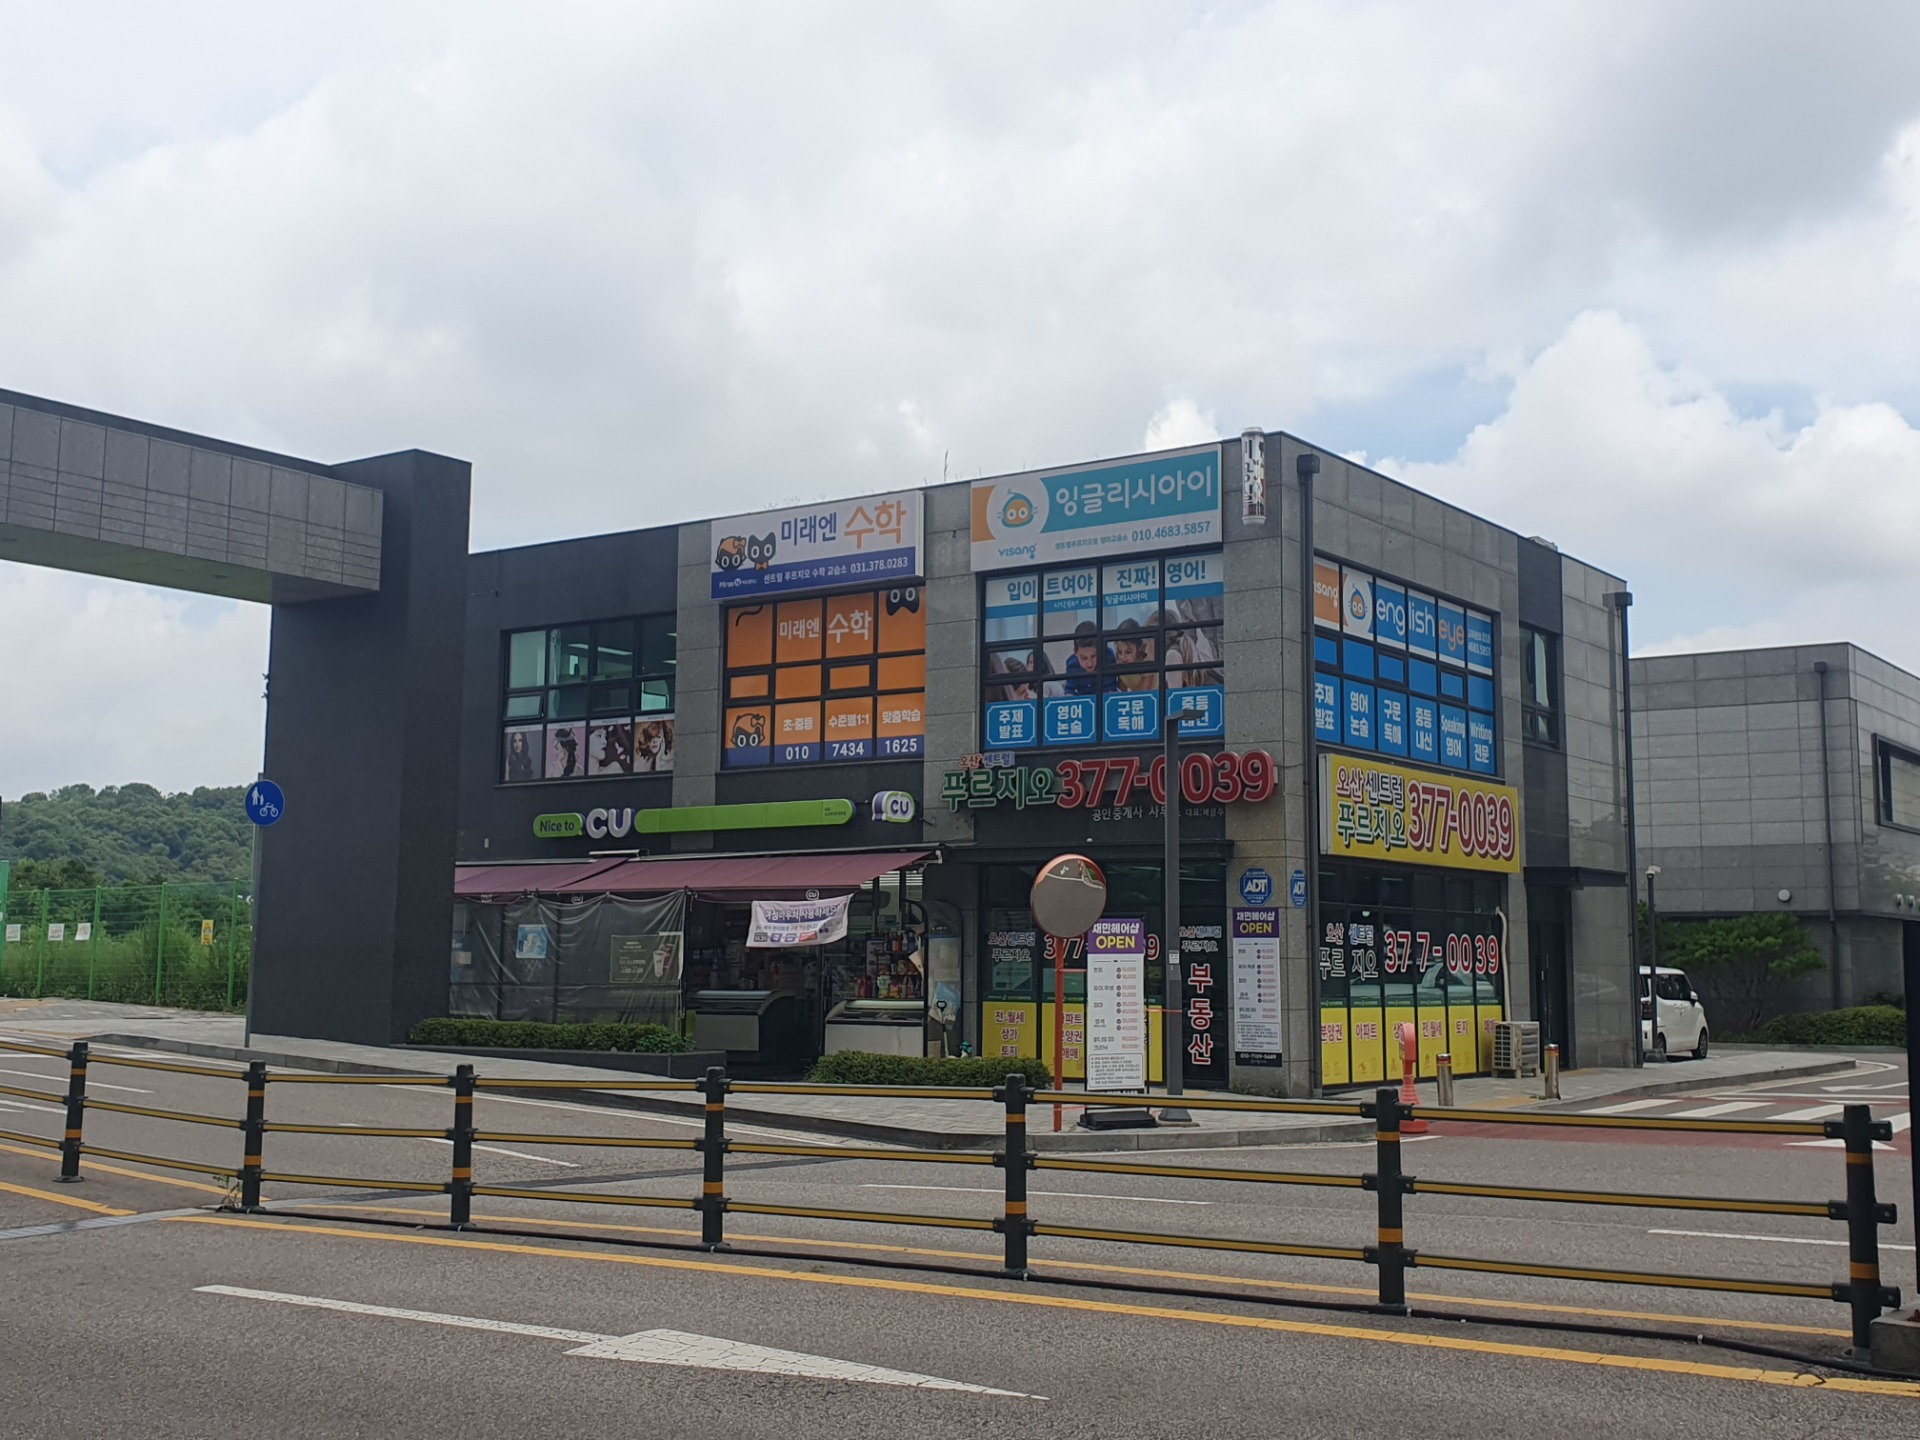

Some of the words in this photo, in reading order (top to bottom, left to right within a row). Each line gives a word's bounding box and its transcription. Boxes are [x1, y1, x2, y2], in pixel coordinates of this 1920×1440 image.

[1055, 465, 1212, 517] 잉글리시아이
[781, 512, 837, 546] 미래엔
[844, 500, 907, 549] 수학
[1132, 520, 1211, 542] 010.4683.5857
[998, 543, 1037, 559] visang
[785, 569, 810, 581] 푸르지오
[850, 557, 908, 574] 031.378.0283
[1007, 579, 1037, 601] 입이
[1045, 573, 1094, 596] 트여야
[1116, 565, 1157, 589] 진짜!
[1167, 559, 1206, 582] 영어!
[779, 617, 820, 640] 미래엔
[828, 609, 872, 643] 수학
[1376, 598, 1435, 638] english
[1438, 617, 1465, 651] eye
[1315, 682, 1334, 706] 주제
[1350, 691, 1369, 714] 영어
[882, 709, 921, 724] 맞춤학습
[999, 709, 1023, 723] 주제
[1057, 704, 1082, 719] 영어
[1117, 700, 1144, 716] 구문
[1384, 699, 1401, 722] 구문
[1415, 706, 1432, 729] 중등
[1057, 720, 1082, 735] 논술
[1117, 715, 1144, 731] 독해
[1315, 708, 1334, 731] 발표
[1350, 715, 1369, 738] 논술
[1441, 714, 1466, 738] Speaking
[999, 724, 1023, 738] 발표
[1416, 731, 1433, 751] 내신
[1470, 721, 1492, 744] Writing
[785, 746, 809, 760] 010
[832, 742, 864, 757] 7434
[885, 738, 917, 754] 1625
[1446, 737, 1462, 758] 영어
[1474, 743, 1490, 764] 전문
[940, 766, 1057, 813] 푸르지오
[1336, 765, 1364, 803] 오산
[1365, 769, 1405, 809] 센트럴
[890, 798, 910, 817] CU
[1092, 806, 1143, 821] 공인중개사
[540, 820, 562, 833] Nice
[564, 820, 575, 832] to
[585, 807, 632, 840] CU
[1336, 801, 1408, 850] 푸르지오
[1407, 779, 1515, 860] 377-0039
[1244, 879, 1268, 893] ADT
[1240, 922, 1273, 934] OPEN
[1325, 922, 1345, 945] 오산
[1349, 923, 1374, 946] 센트럴
[1096, 935, 1136, 949] OPEN
[1181, 940, 1219, 952] 푸르지오
[991, 949, 1032, 963] 푸르지오
[1062, 1012, 1084, 1025] 파트
[1187, 962, 1213, 1066] 부동산
[1001, 1028, 1019, 1041] 상가
[1062, 1030, 1083, 1043] 양권
[1320, 1022, 1344, 1043] 분양권
[1355, 1023, 1378, 1040] 아파트
[1456, 1019, 1469, 1036] 토지
[1001, 1045, 1019, 1057] 토지
